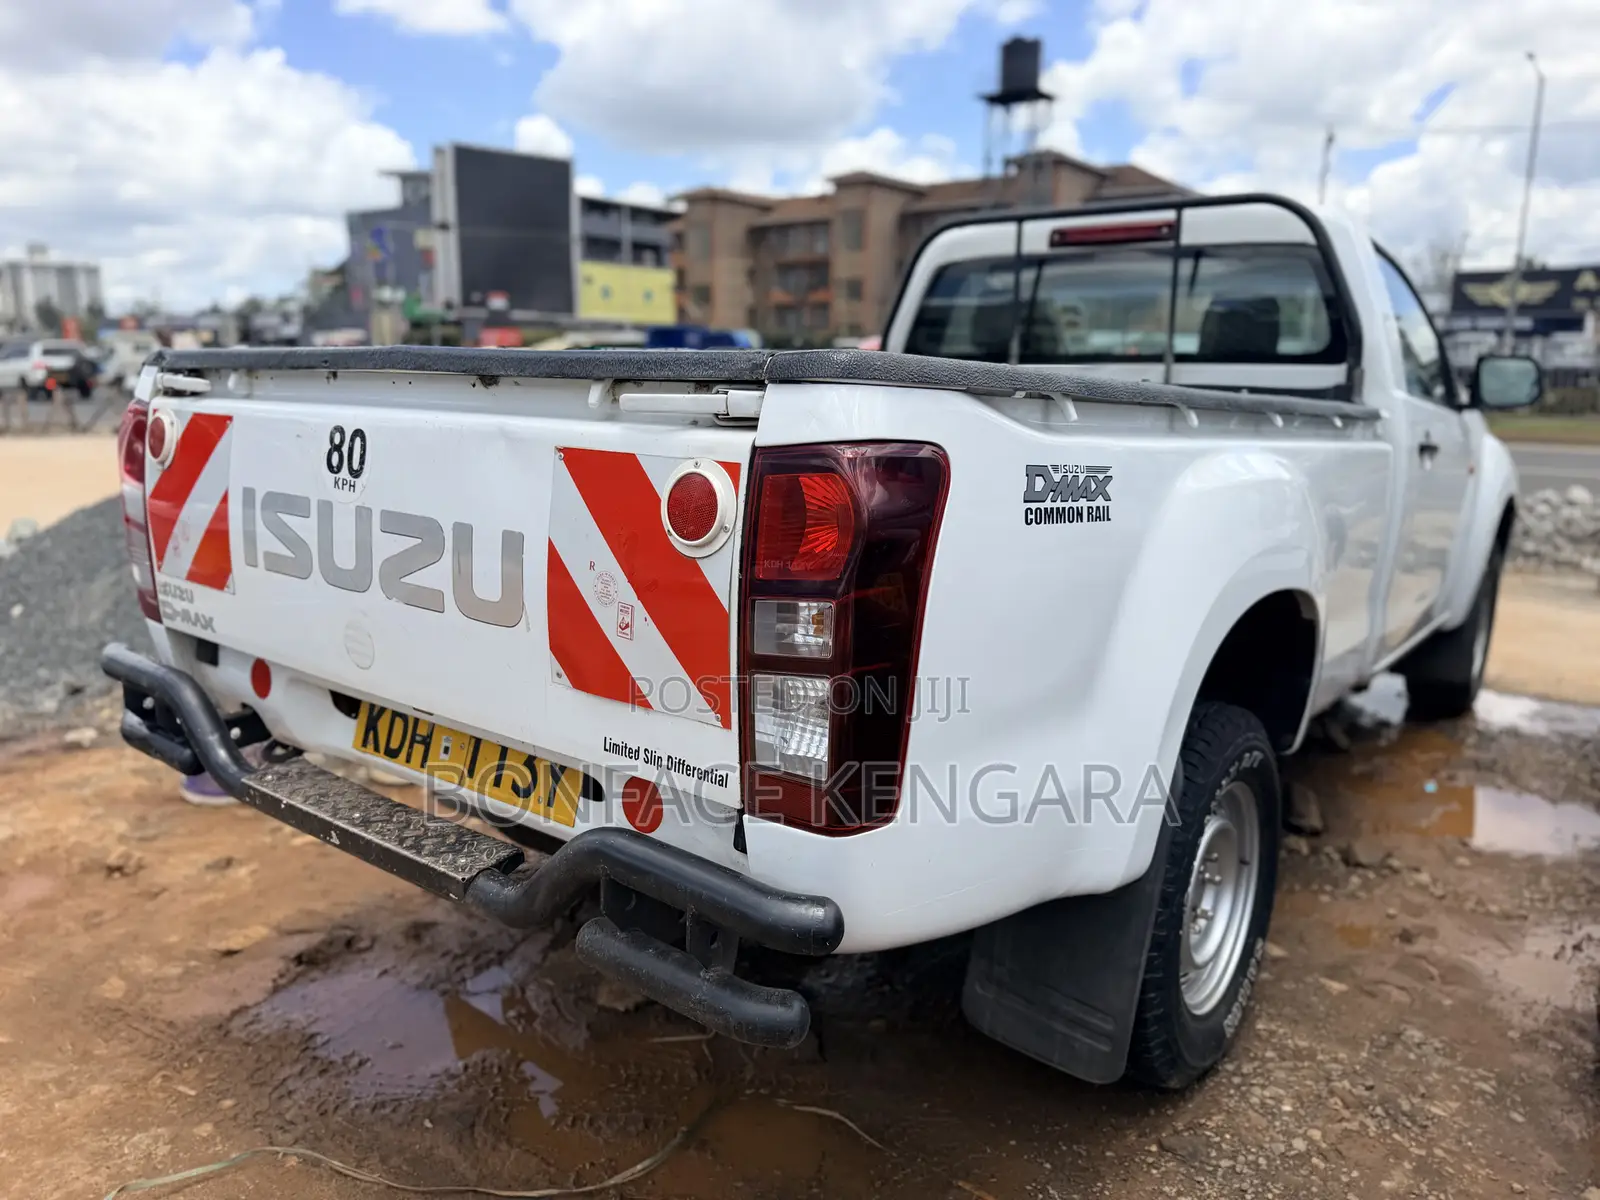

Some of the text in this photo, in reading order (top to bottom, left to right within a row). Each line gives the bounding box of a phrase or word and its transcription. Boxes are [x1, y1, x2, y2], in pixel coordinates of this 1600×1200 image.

[326, 425, 367, 479] 80
[1060, 464, 1085, 474] ISUZU
[333, 476, 356, 493] KPH
[1024, 505, 1112, 526] COMMON RAIL
[242, 486, 525, 628] ISUZU
[361, 702, 435, 769] KDH
[603, 736, 729, 788] Limited Slip Differential
